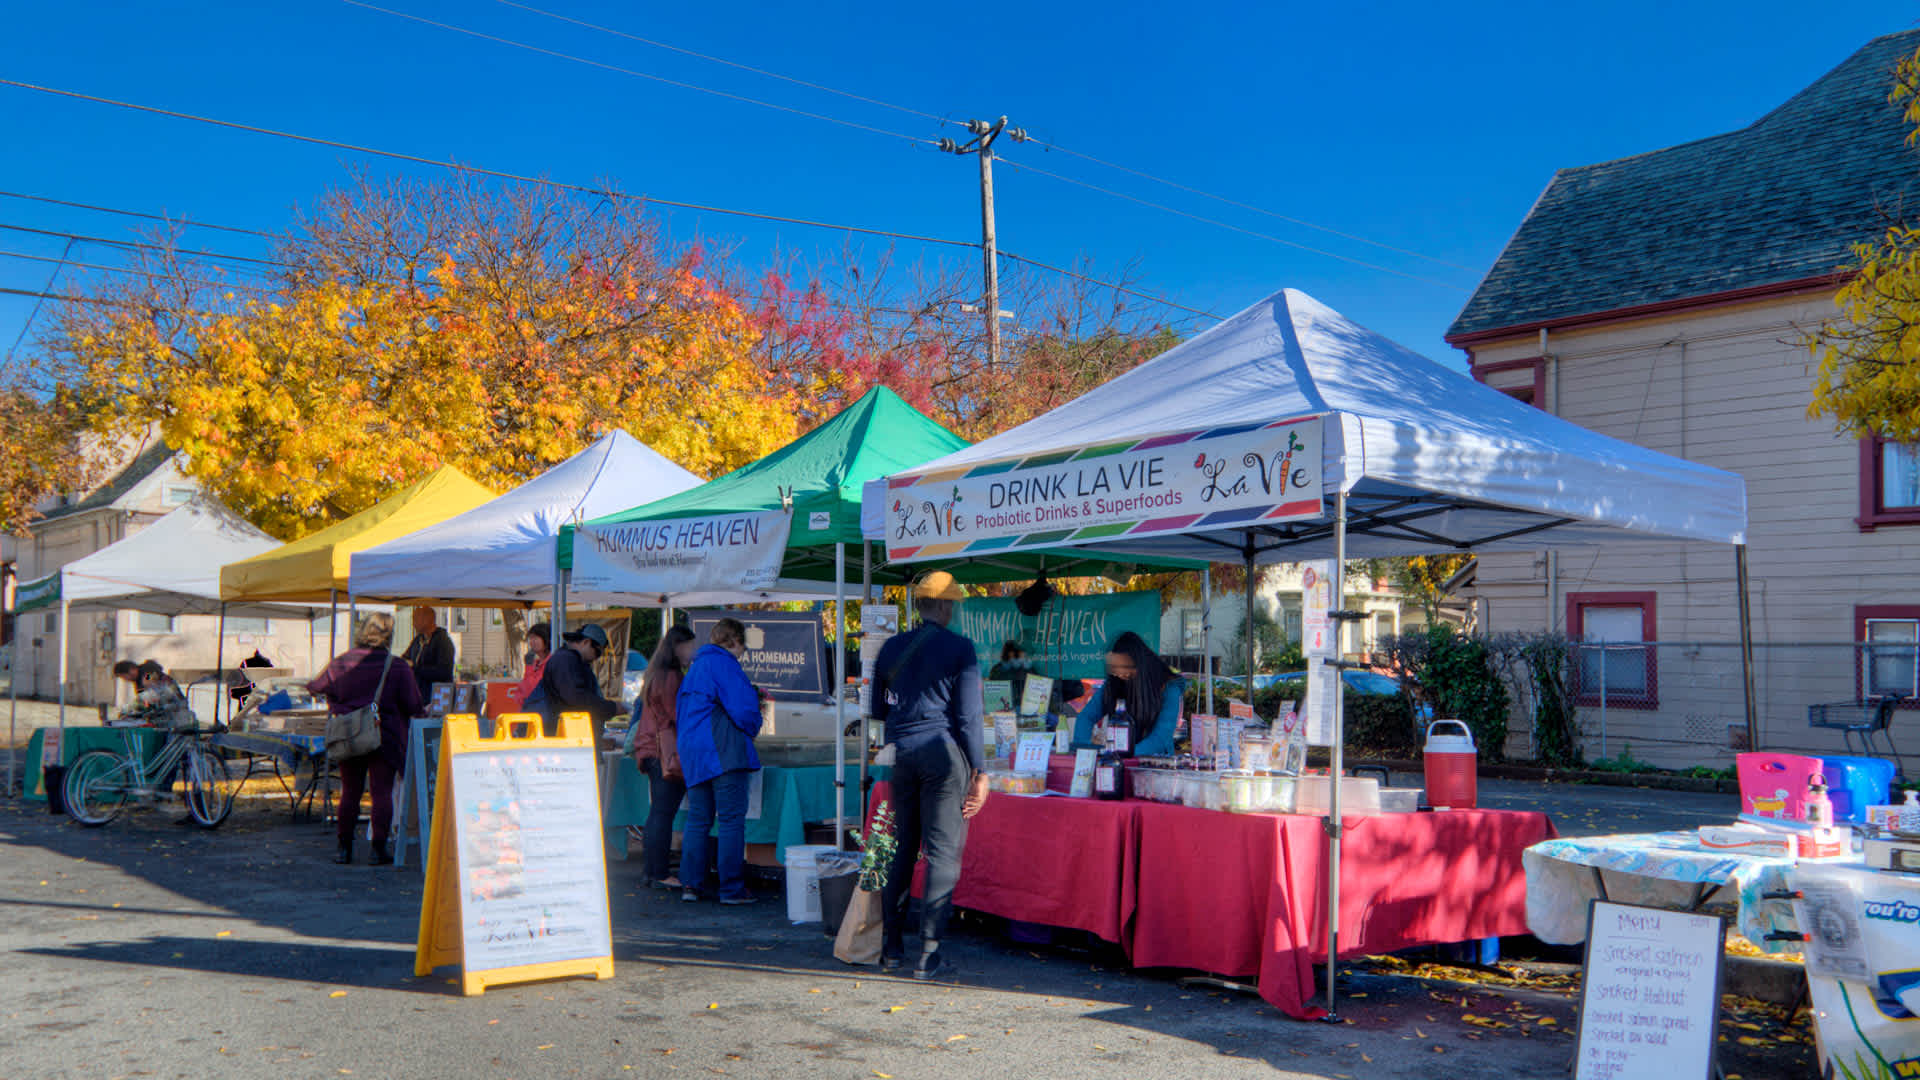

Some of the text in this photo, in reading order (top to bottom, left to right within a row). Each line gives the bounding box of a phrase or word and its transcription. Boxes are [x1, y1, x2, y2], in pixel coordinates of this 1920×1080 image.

[989, 457, 1165, 510] DRINK LA VIE
[975, 509, 1032, 529] Probiotic
[1035, 503, 1078, 523] Drinks
[1082, 501, 1092, 516] &
[1096, 489, 1183, 516] Superfoods
[595, 517, 760, 553] HUMMUS HEAVEN
[960, 608, 1108, 646] HUMMUS HEAVEN
[751, 650, 806, 665] HOMEMADE
[1618, 912, 1661, 930] Menu
